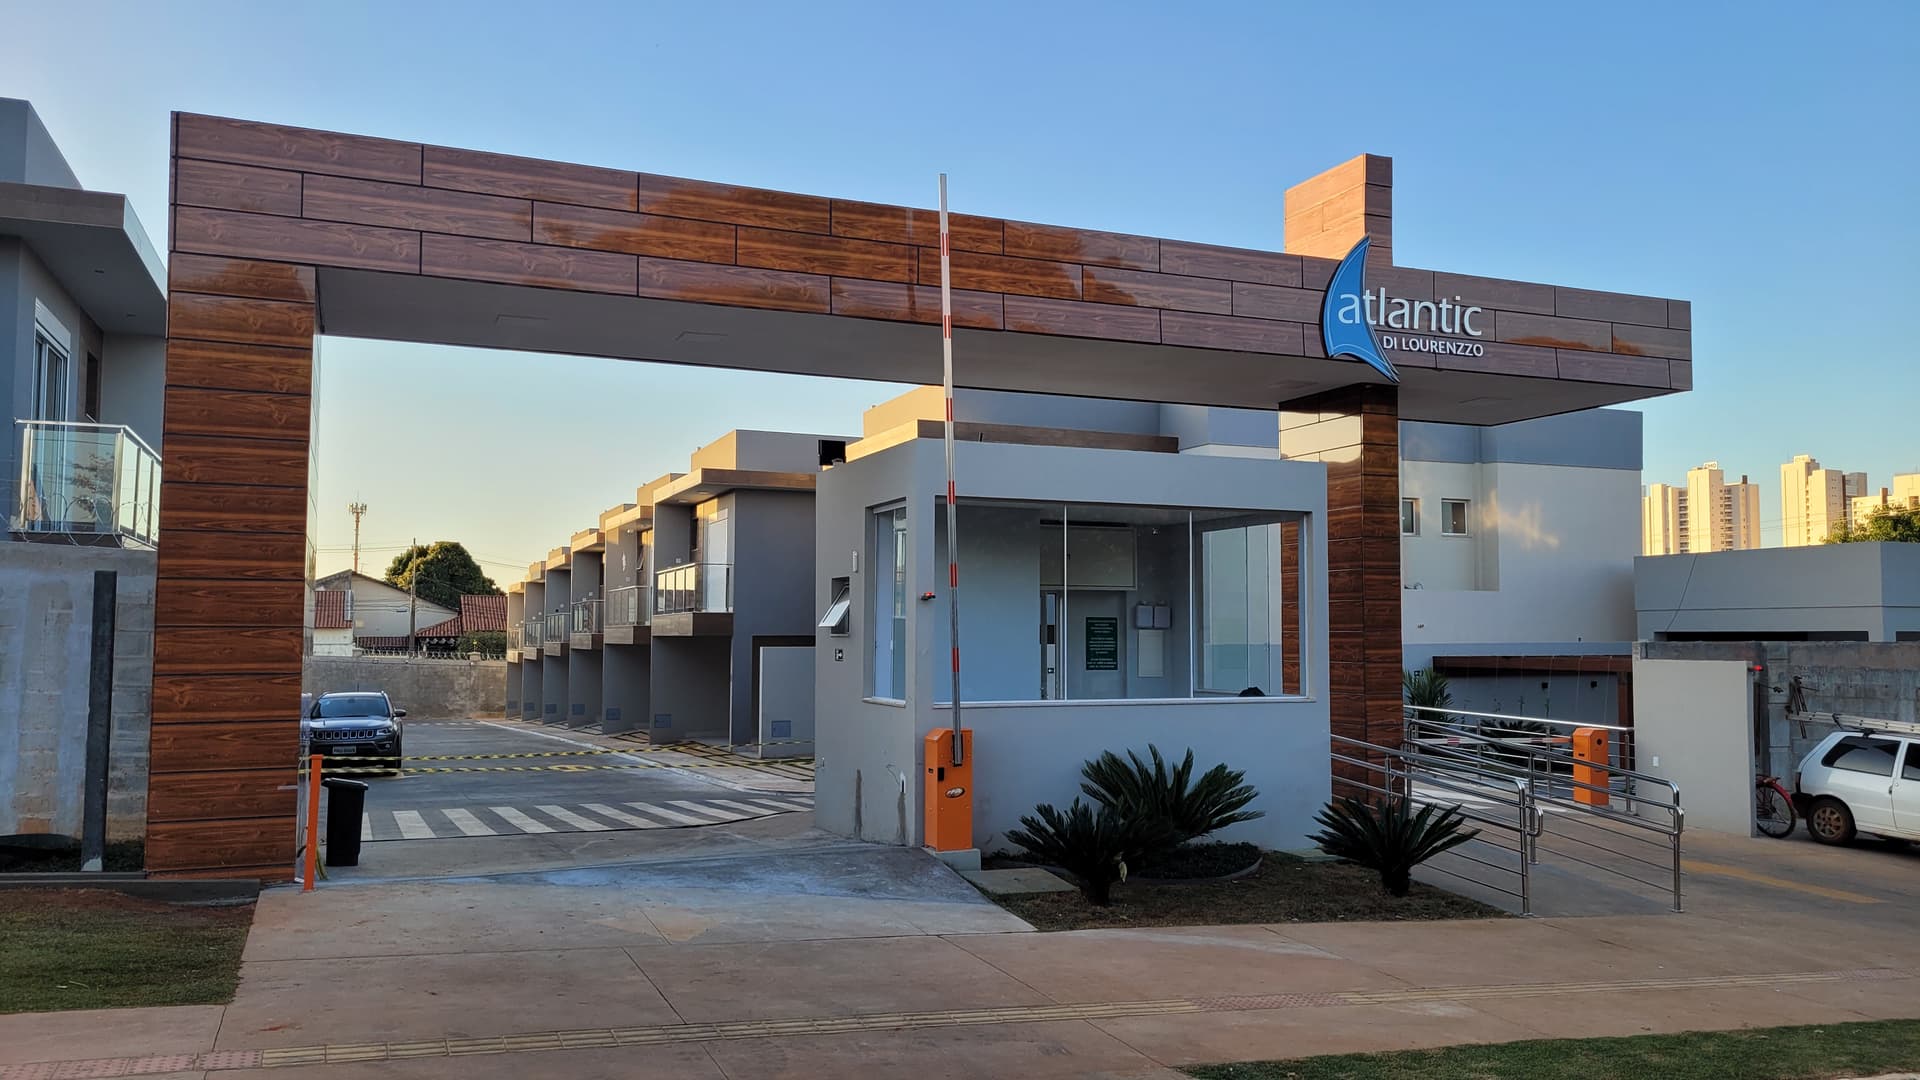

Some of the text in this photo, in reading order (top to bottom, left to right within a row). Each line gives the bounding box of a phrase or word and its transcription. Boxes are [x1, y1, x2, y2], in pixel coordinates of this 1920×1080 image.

[1338, 287, 1482, 336] atlantic
[1383, 335, 1484, 357] DI LOURENZZO
